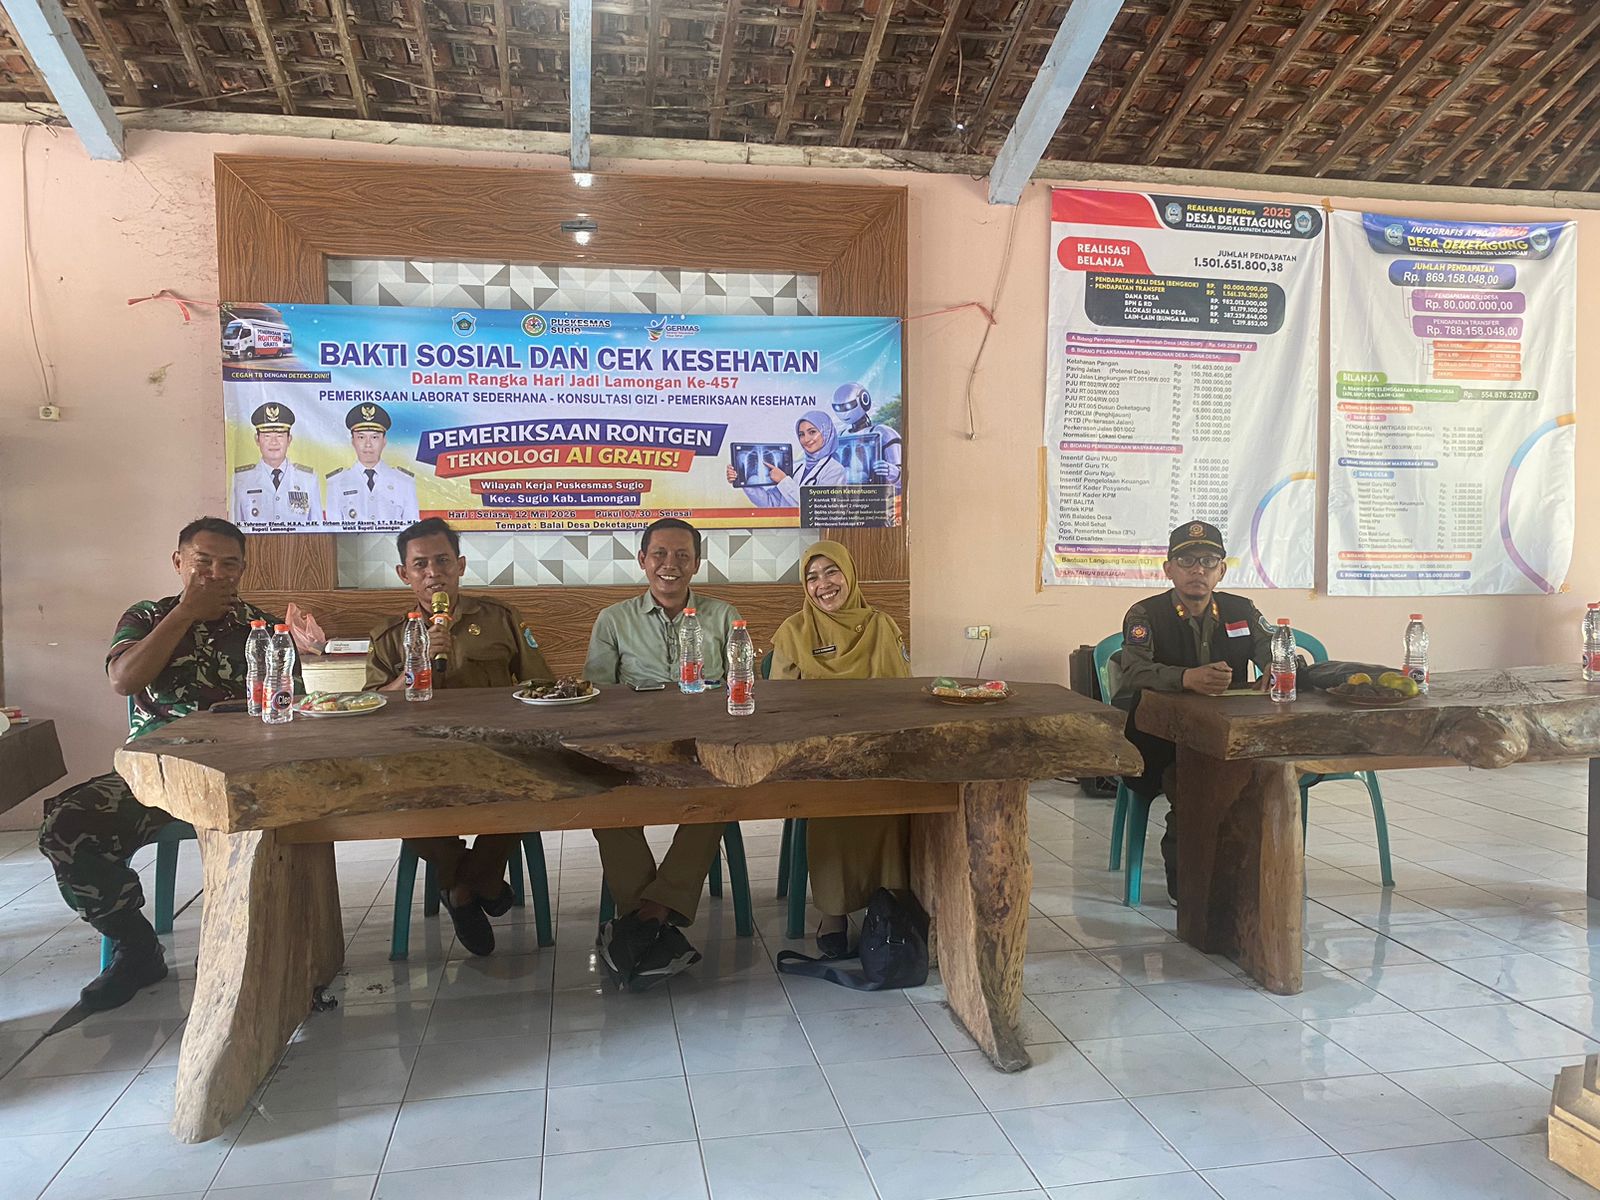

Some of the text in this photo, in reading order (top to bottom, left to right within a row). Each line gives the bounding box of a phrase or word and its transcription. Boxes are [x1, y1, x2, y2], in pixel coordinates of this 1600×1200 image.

[1187, 204, 1226, 213] REALISASI
[1263, 207, 1291, 217] 2025
[1186, 213, 1292, 229] DESA DEKETAGUNG
[1411, 226, 1464, 237] INFOGRAFIS
[1407, 236, 1438, 248] DESA
[1077, 243, 1130, 255] REALISASI
[1077, 256, 1124, 267] BELANJA
[1218, 250, 1297, 262] JUMLAH PENDAPATAN
[1194, 257, 1283, 273] 1.501.651.800,38
[1413, 263, 1495, 273] JUMLAH PENDAPATAN
[1403, 272, 1498, 285] Rp. 869.158.048,00
[1095, 283, 1165, 293] PENDAPATAN TRANSFER
[1425, 300, 1513, 312] Rp. 80.000.000,00
[551, 319, 611, 328] PUSKESMAS
[1427, 325, 1518, 337] Rp. 788.158.048,00
[320, 343, 818, 372] BAKTI SOSIAL DAN CEK KESEHATAN
[412, 372, 739, 390] Dalam Rangka Hari Jadi Lamongan Ke-457
[320, 390, 816, 406] PEMERIKSAAN LABORAT SEDERHANA KONSULTASI GIZI PEMERIKSAAN KESEHATAN
[428, 423, 712, 449] PEMERIKSAAN RONTGEN
[447, 447, 680, 469] TEKNOLOGI AI GRATIS!
[481, 481, 644, 491] Wilayah Kerja Puskesmas Sugio
[489, 495, 637, 504] Kec. Sugio Kab. Lamongan
[476, 511, 512, 519] Selasa,
[595, 510, 622, 518] Pukul
[496, 521, 651, 530] Tempat Balai Desa Deketagung
